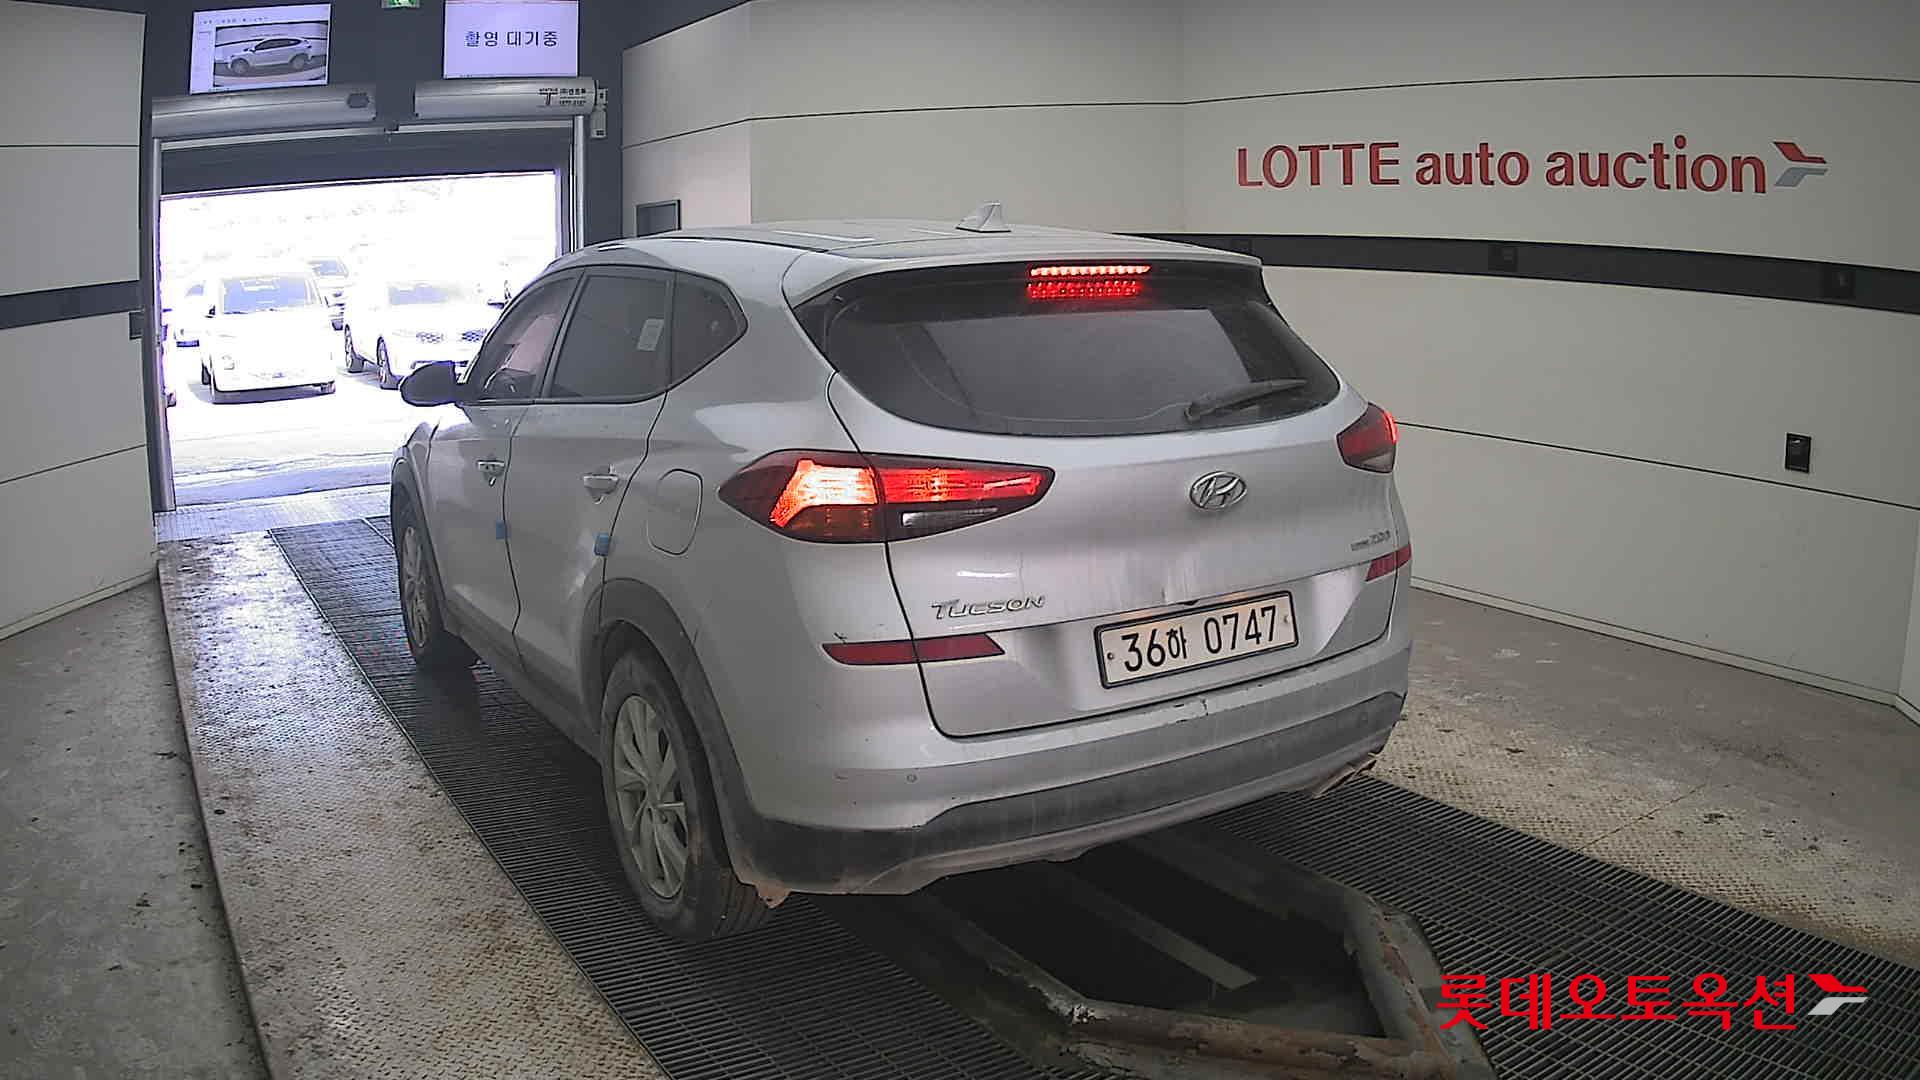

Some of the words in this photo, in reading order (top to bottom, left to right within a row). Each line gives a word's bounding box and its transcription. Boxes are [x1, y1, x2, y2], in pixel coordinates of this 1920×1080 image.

[506, 30, 559, 48] 대기중
[1236, 142, 1400, 188] LOTTE
[1415, 142, 1530, 187] auto
[1545, 135, 1767, 194] auction
[931, 596, 1045, 620] TUCSON
[1121, 626, 1188, 672] 36하
[1204, 605, 1277, 655] 0747
